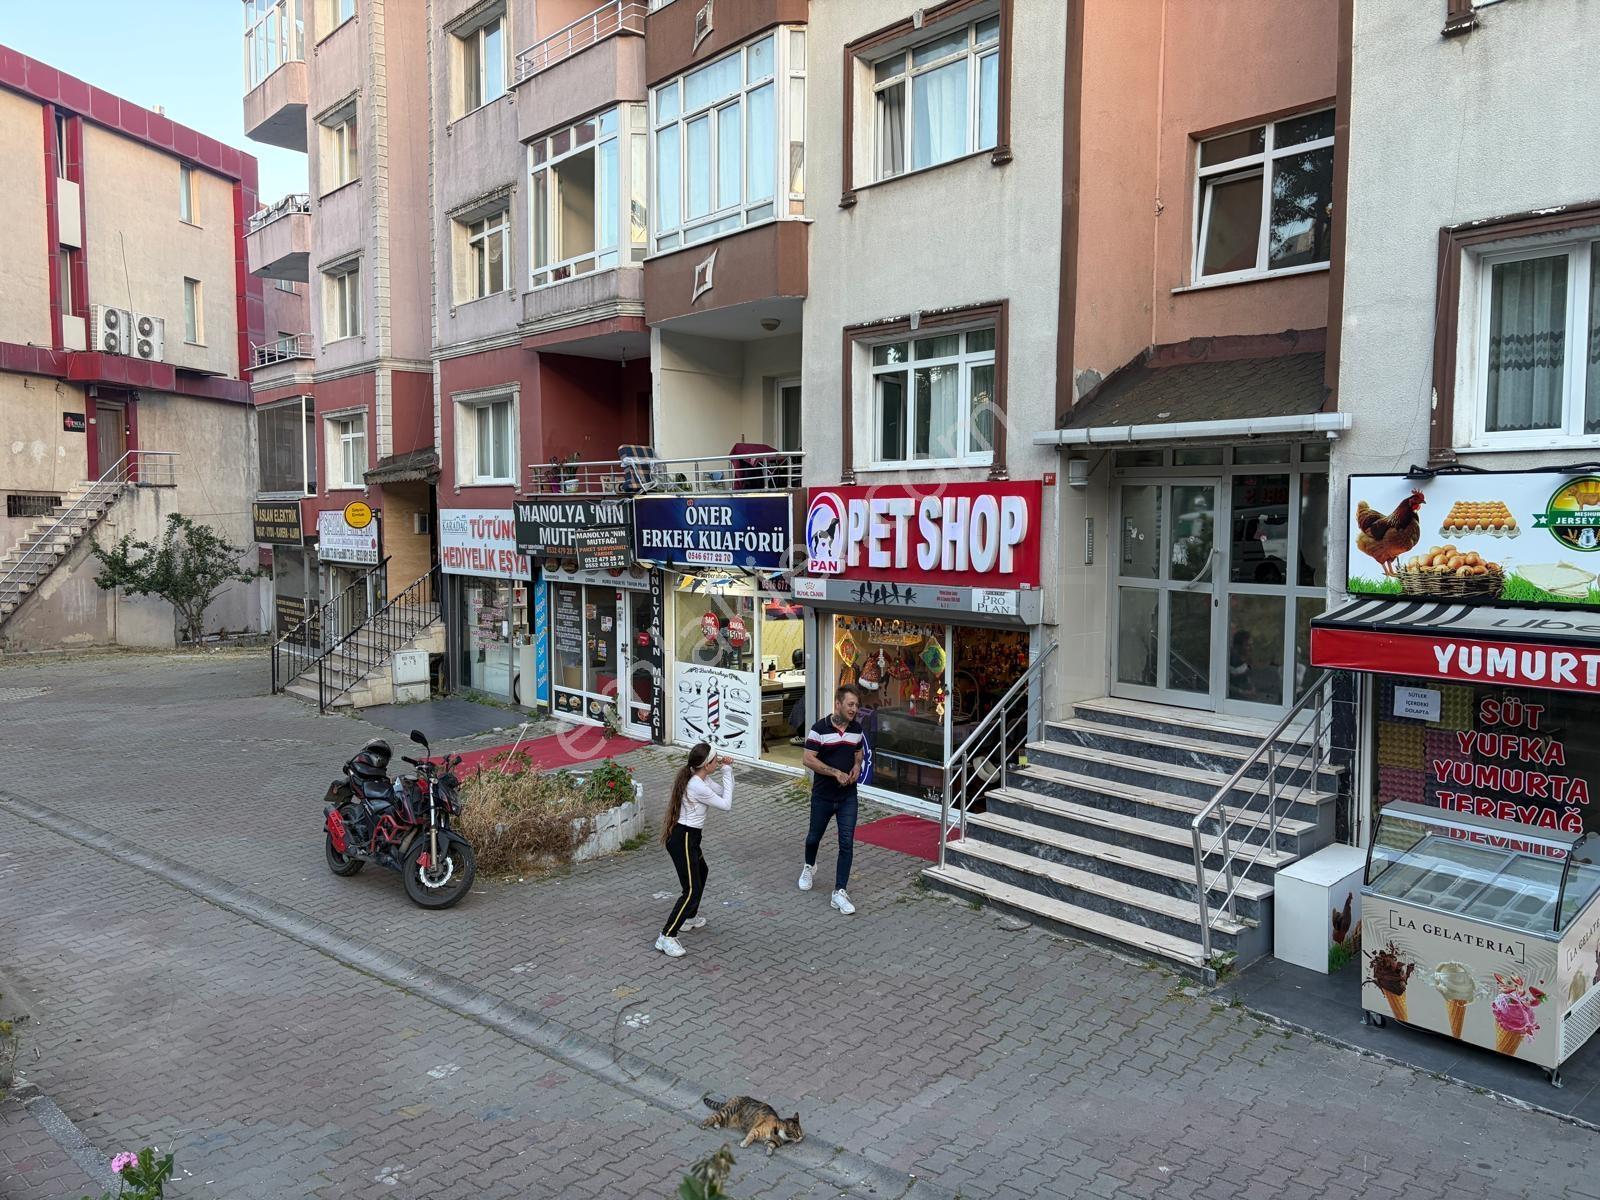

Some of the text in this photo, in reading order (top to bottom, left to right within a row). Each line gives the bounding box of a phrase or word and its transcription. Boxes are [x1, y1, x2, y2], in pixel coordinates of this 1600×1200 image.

[519, 504, 586, 523] MANOLYA
[686, 500, 733, 526] ÖNER
[1555, 517, 1596, 525] JERSEY
[539, 527, 575, 546] MUTF
[576, 531, 610, 539] MANOLYA
[642, 526, 785, 553] ERKEK KUAFÖRÜ
[442, 541, 529, 578] HEDİYELİK EŞYA
[687, 552, 731, 563] 0546 677 22 70
[810, 560, 838, 572] PAN
[977, 603, 1010, 614] PLAN
[982, 595, 1006, 606] PRO
[1479, 696, 1545, 731] SÜT
[1456, 730, 1566, 767] YUFKA
[1432, 759, 1590, 805] YUMURTA
[1398, 916, 1516, 957] LA GELATERIA
